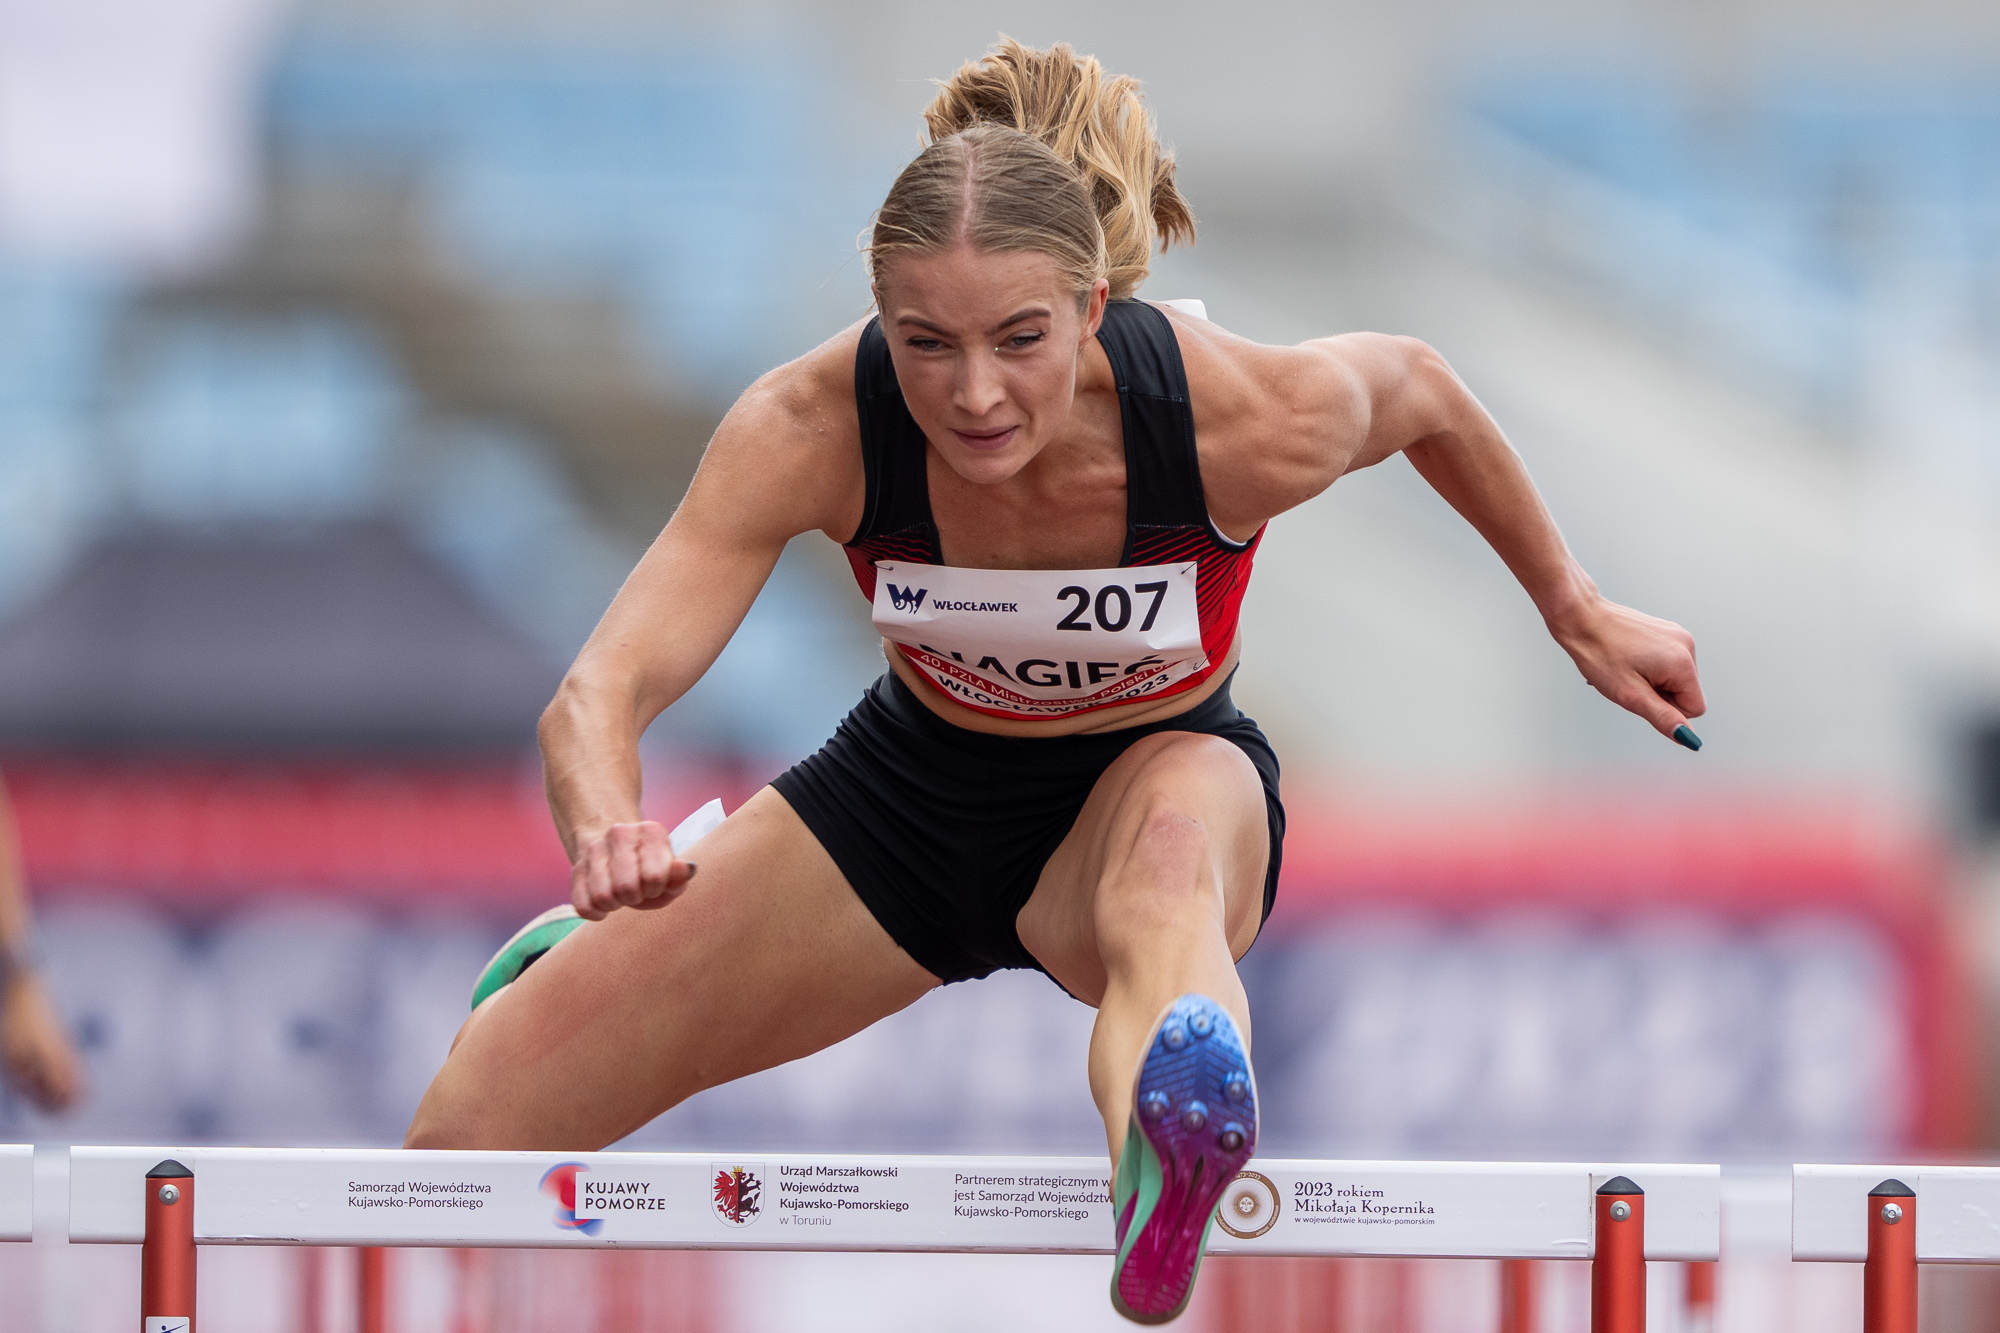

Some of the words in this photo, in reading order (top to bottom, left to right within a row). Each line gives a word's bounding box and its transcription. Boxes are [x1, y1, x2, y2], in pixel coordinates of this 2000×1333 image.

[933, 599, 1019, 612] WŁOCŁAWEK
[1056, 580, 1169, 632] 207
[921, 654, 945, 671] 40.
[949, 666, 986, 690] PZLA
[991, 684, 1096, 705] Mistrzostwa
[1101, 671, 1148, 698] Polski
[938, 674, 1105, 712] WŁOCŁAWEK
[780, 1166, 813, 1178] Urząd
[816, 1166, 898, 1177] Marszałkowski
[348, 1181, 405, 1195] Samorząd
[408, 1182, 491, 1194] Województwa
[585, 1182, 651, 1194] KUJAWY
[780, 1182, 859, 1194] Województwa
[955, 1174, 1015, 1186] Partnerem
[1018, 1175, 1099, 1189] strategicznym
[1294, 1181, 1333, 1197] 2023
[1337, 1185, 1384, 1198] rokiem
[348, 1197, 484, 1210] Kujawsko-Pomorskiego
[585, 1198, 666, 1210] POMORZE
[953, 1190, 975, 1203] jest
[978, 1190, 1035, 1204] Samorząd
[1038, 1191, 1113, 1204] Województw
[780, 1198, 910, 1212] Kujawsko-Pomorskiego
[1294, 1199, 1357, 1215] Mikołaja
[1361, 1200, 1435, 1215] Kopernika
[954, 1205, 1089, 1220] Kujawsko-Pomorskiego
[779, 1217, 789, 1225] w
[792, 1215, 832, 1225] Toruniu
[1302, 1216, 1356, 1225] województwie
[1358, 1217, 1435, 1226] kujawsko-pomorskim
